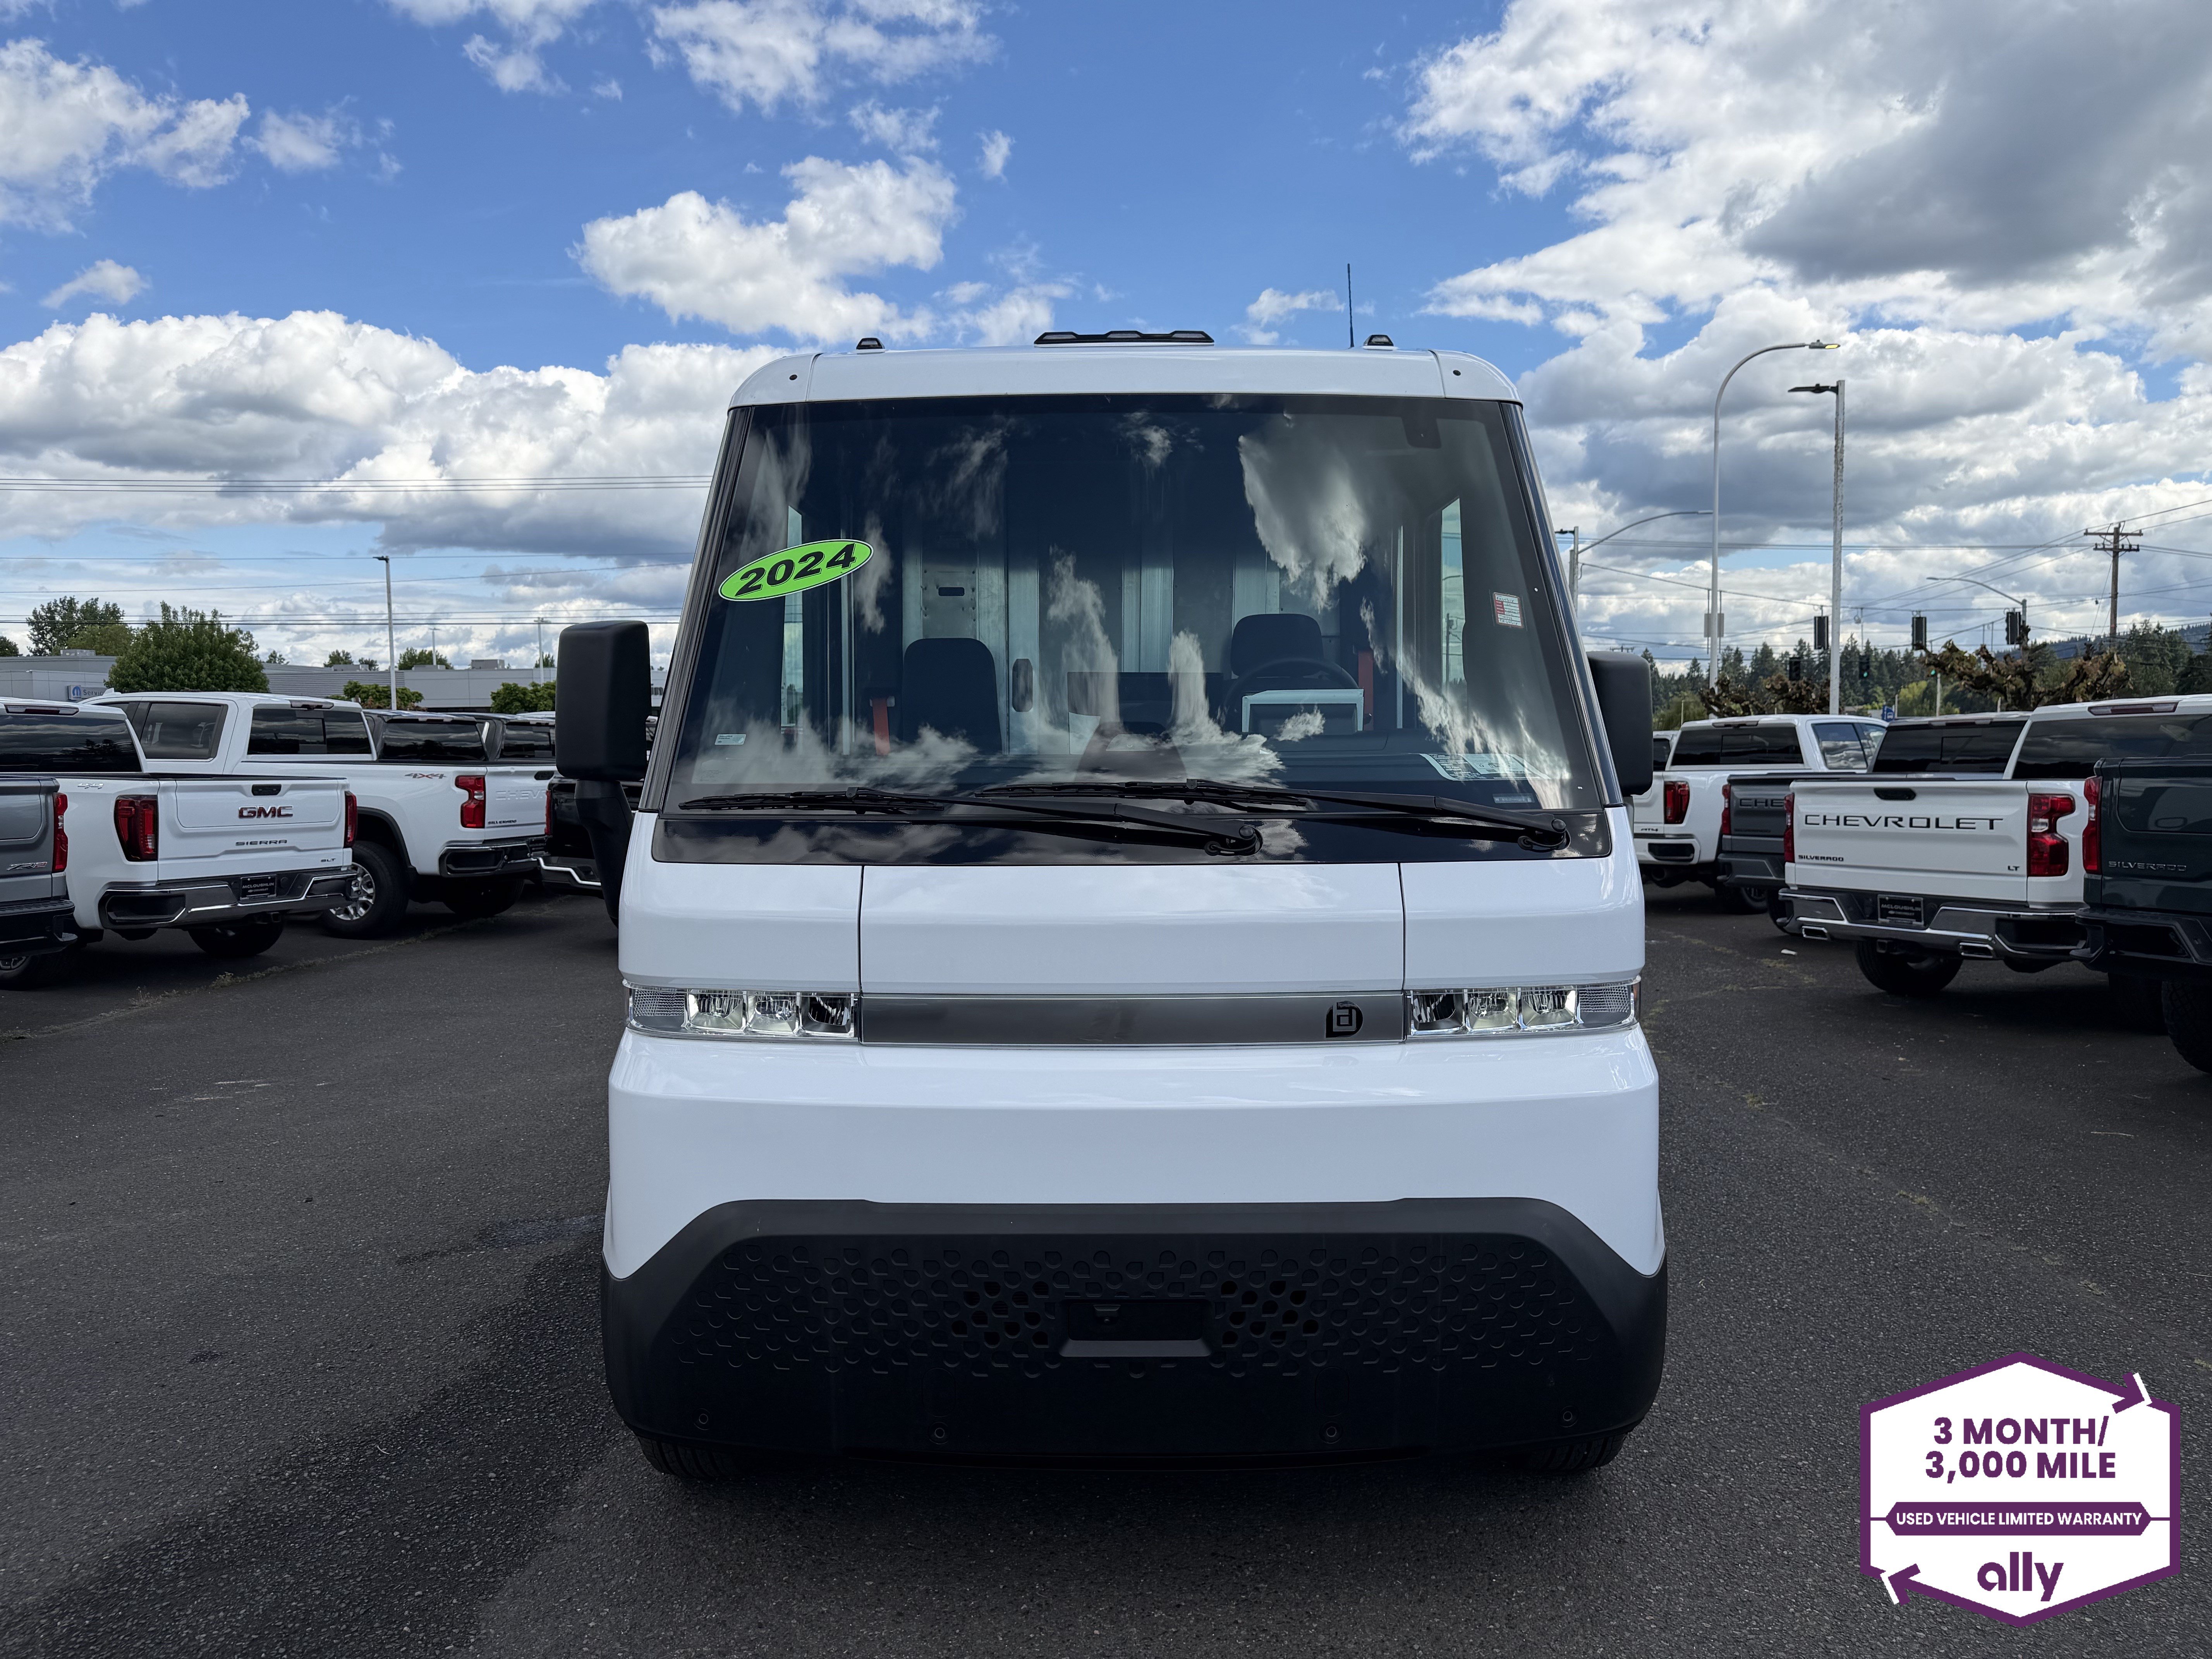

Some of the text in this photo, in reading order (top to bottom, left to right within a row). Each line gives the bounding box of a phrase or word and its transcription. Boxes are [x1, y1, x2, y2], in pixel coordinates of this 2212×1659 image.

[734, 543, 857, 598] 2024
[239, 805, 293, 819] GMC
[1805, 815, 2004, 830] CHEVROLET
[2109, 861, 2186, 871] SILVERADO
